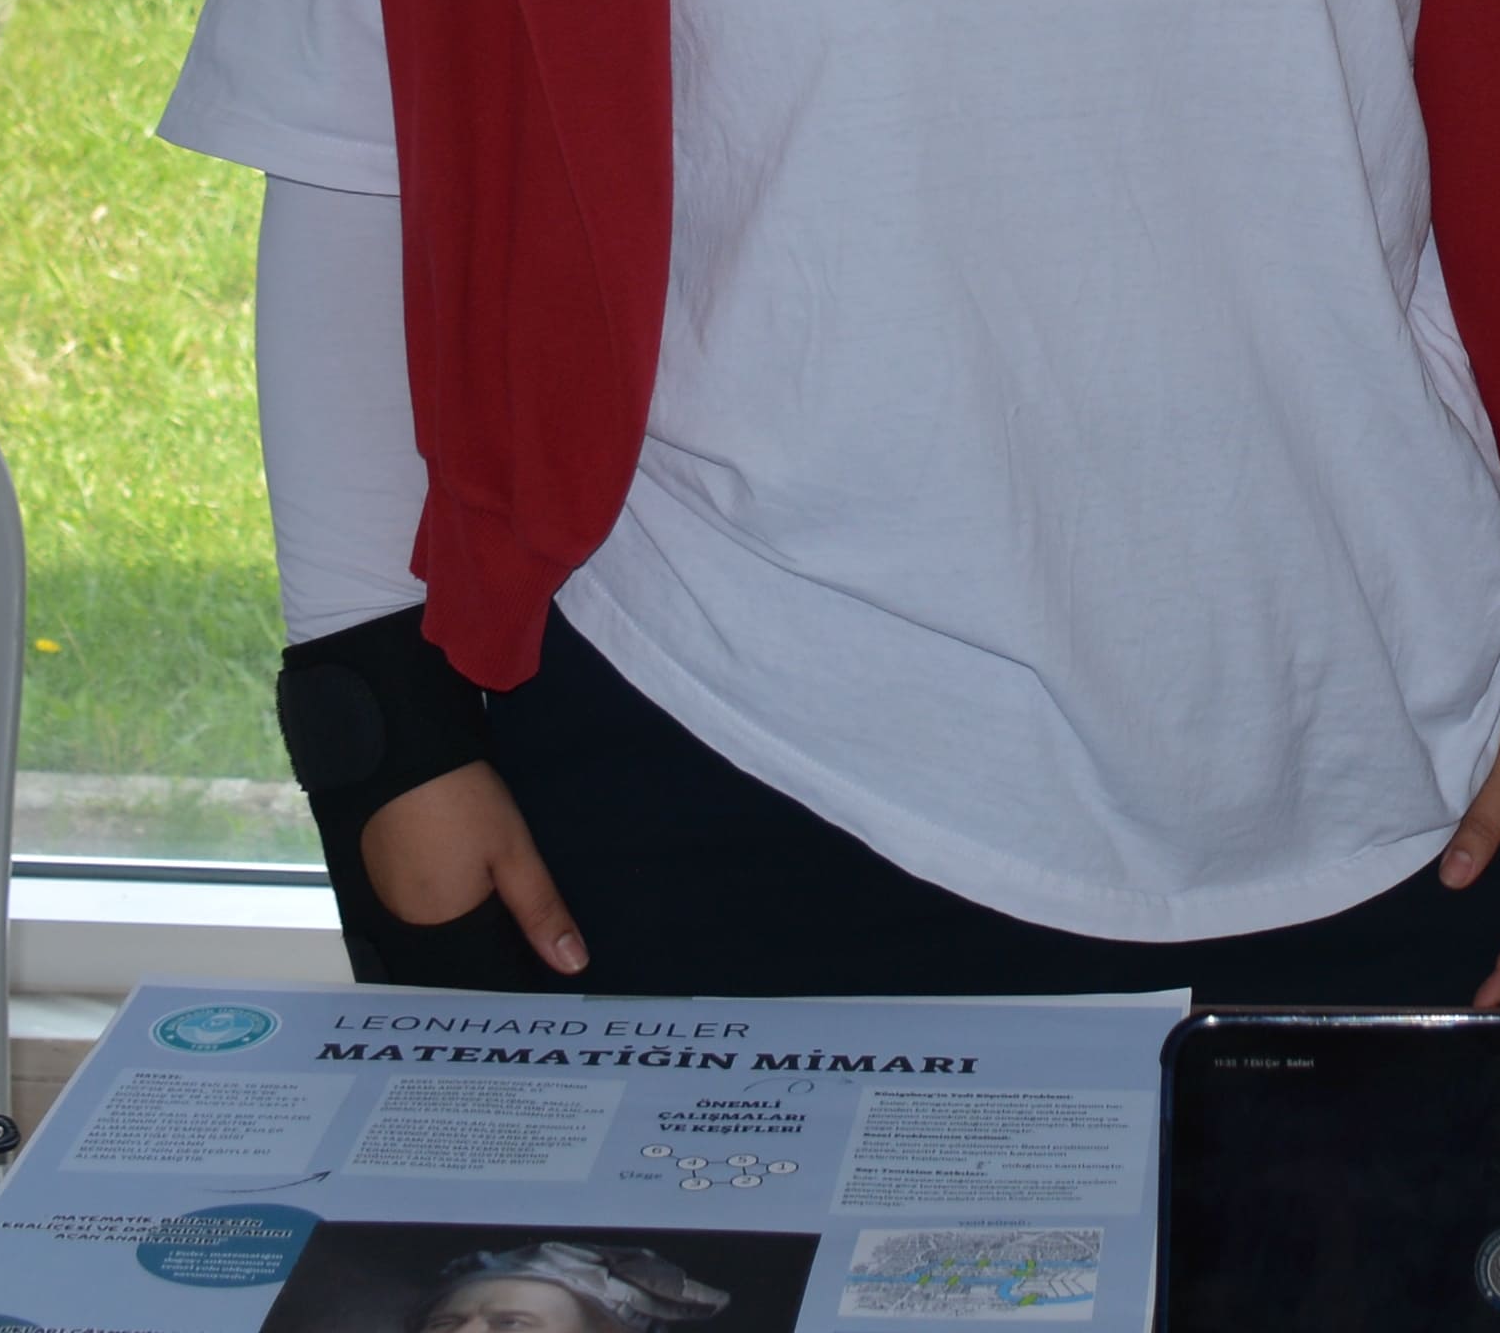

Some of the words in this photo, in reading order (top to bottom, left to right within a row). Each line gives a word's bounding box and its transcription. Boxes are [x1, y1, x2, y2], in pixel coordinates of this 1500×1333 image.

[333, 1014, 588, 1037] LEONHARD
[604, 1020, 751, 1039] EULER
[314, 1041, 737, 1071] MATEMATİĞİN
[750, 1048, 980, 1075] MİMARI
[696, 1098, 782, 1109] ÖNEMLİ
[657, 1111, 807, 1122] ÇALIŞMALARI
[659, 1123, 687, 1132] VE
[692, 1123, 804, 1134] KEŞİFLERİ
